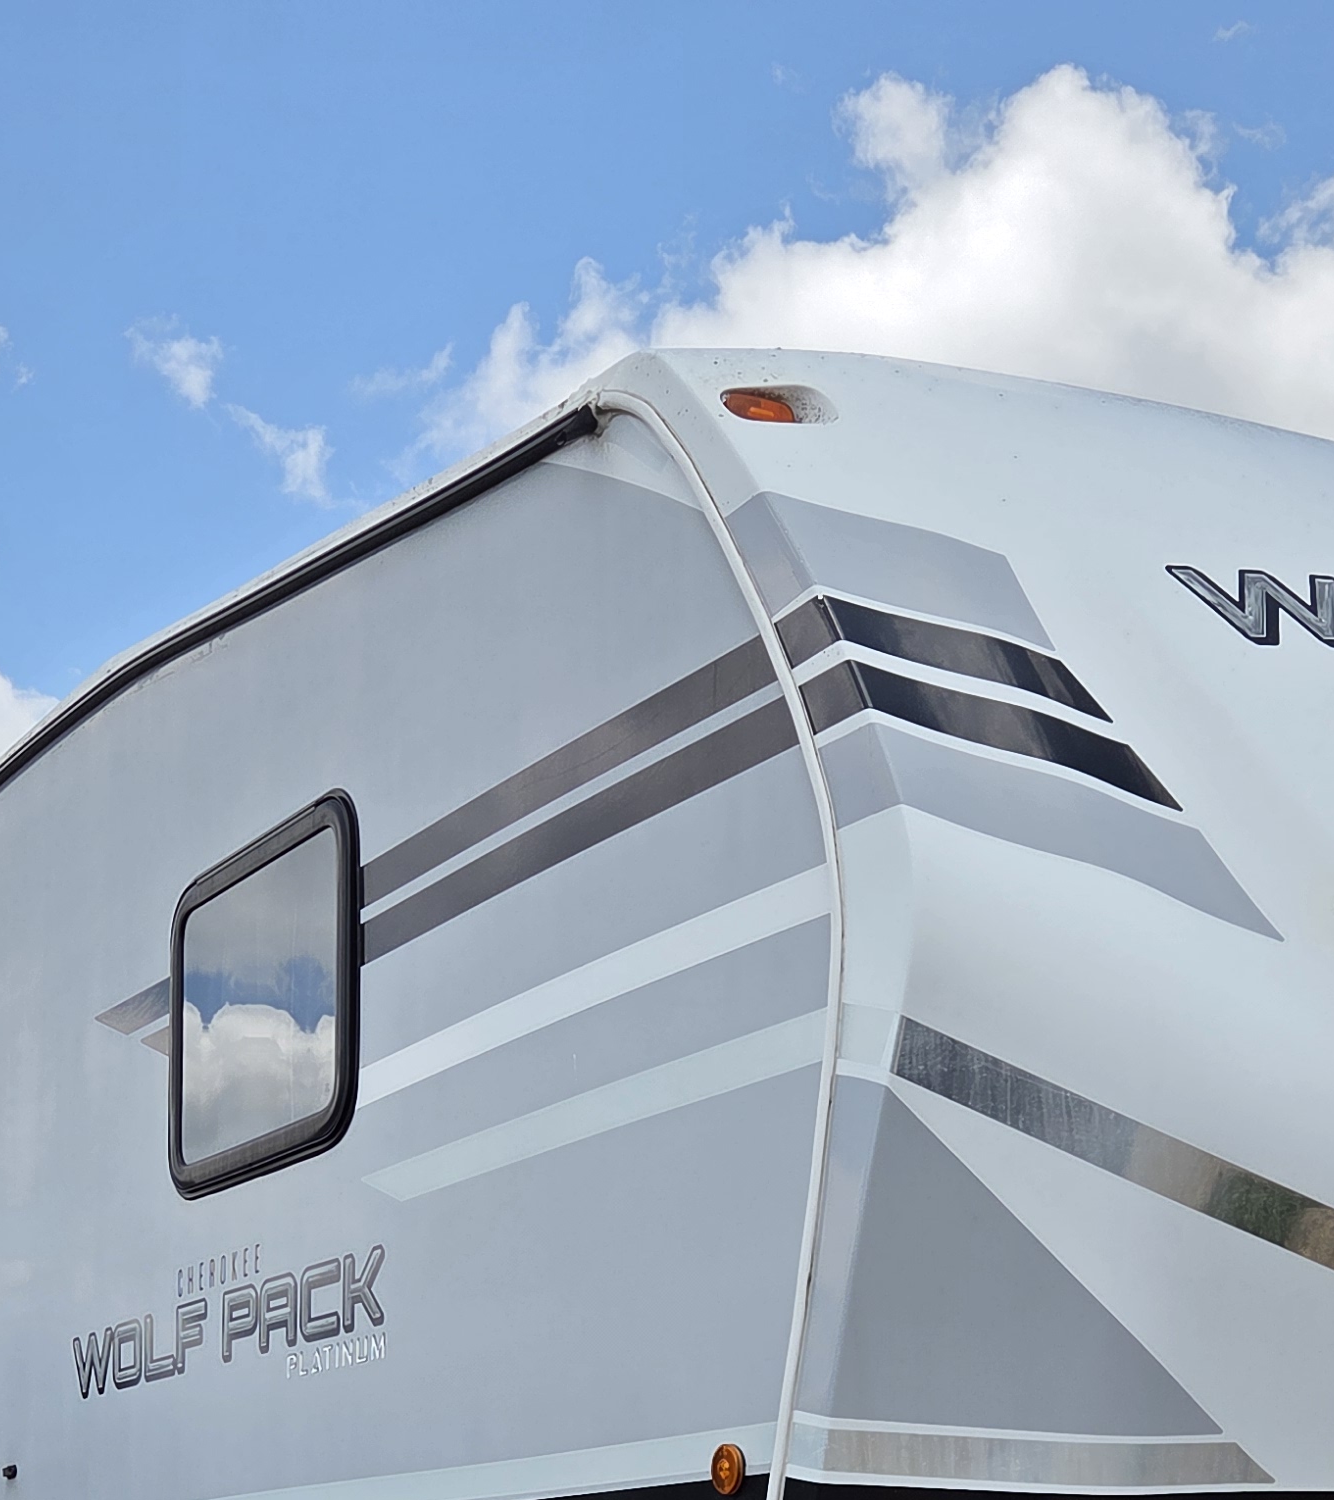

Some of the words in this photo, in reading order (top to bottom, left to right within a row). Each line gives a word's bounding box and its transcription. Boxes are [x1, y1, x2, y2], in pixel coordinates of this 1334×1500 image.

[177, 1243, 261, 1298] CHEROKEE
[73, 1297, 208, 1400] WOLF
[222, 1244, 386, 1364] PACK
[286, 1332, 387, 1380] PLATINUM
